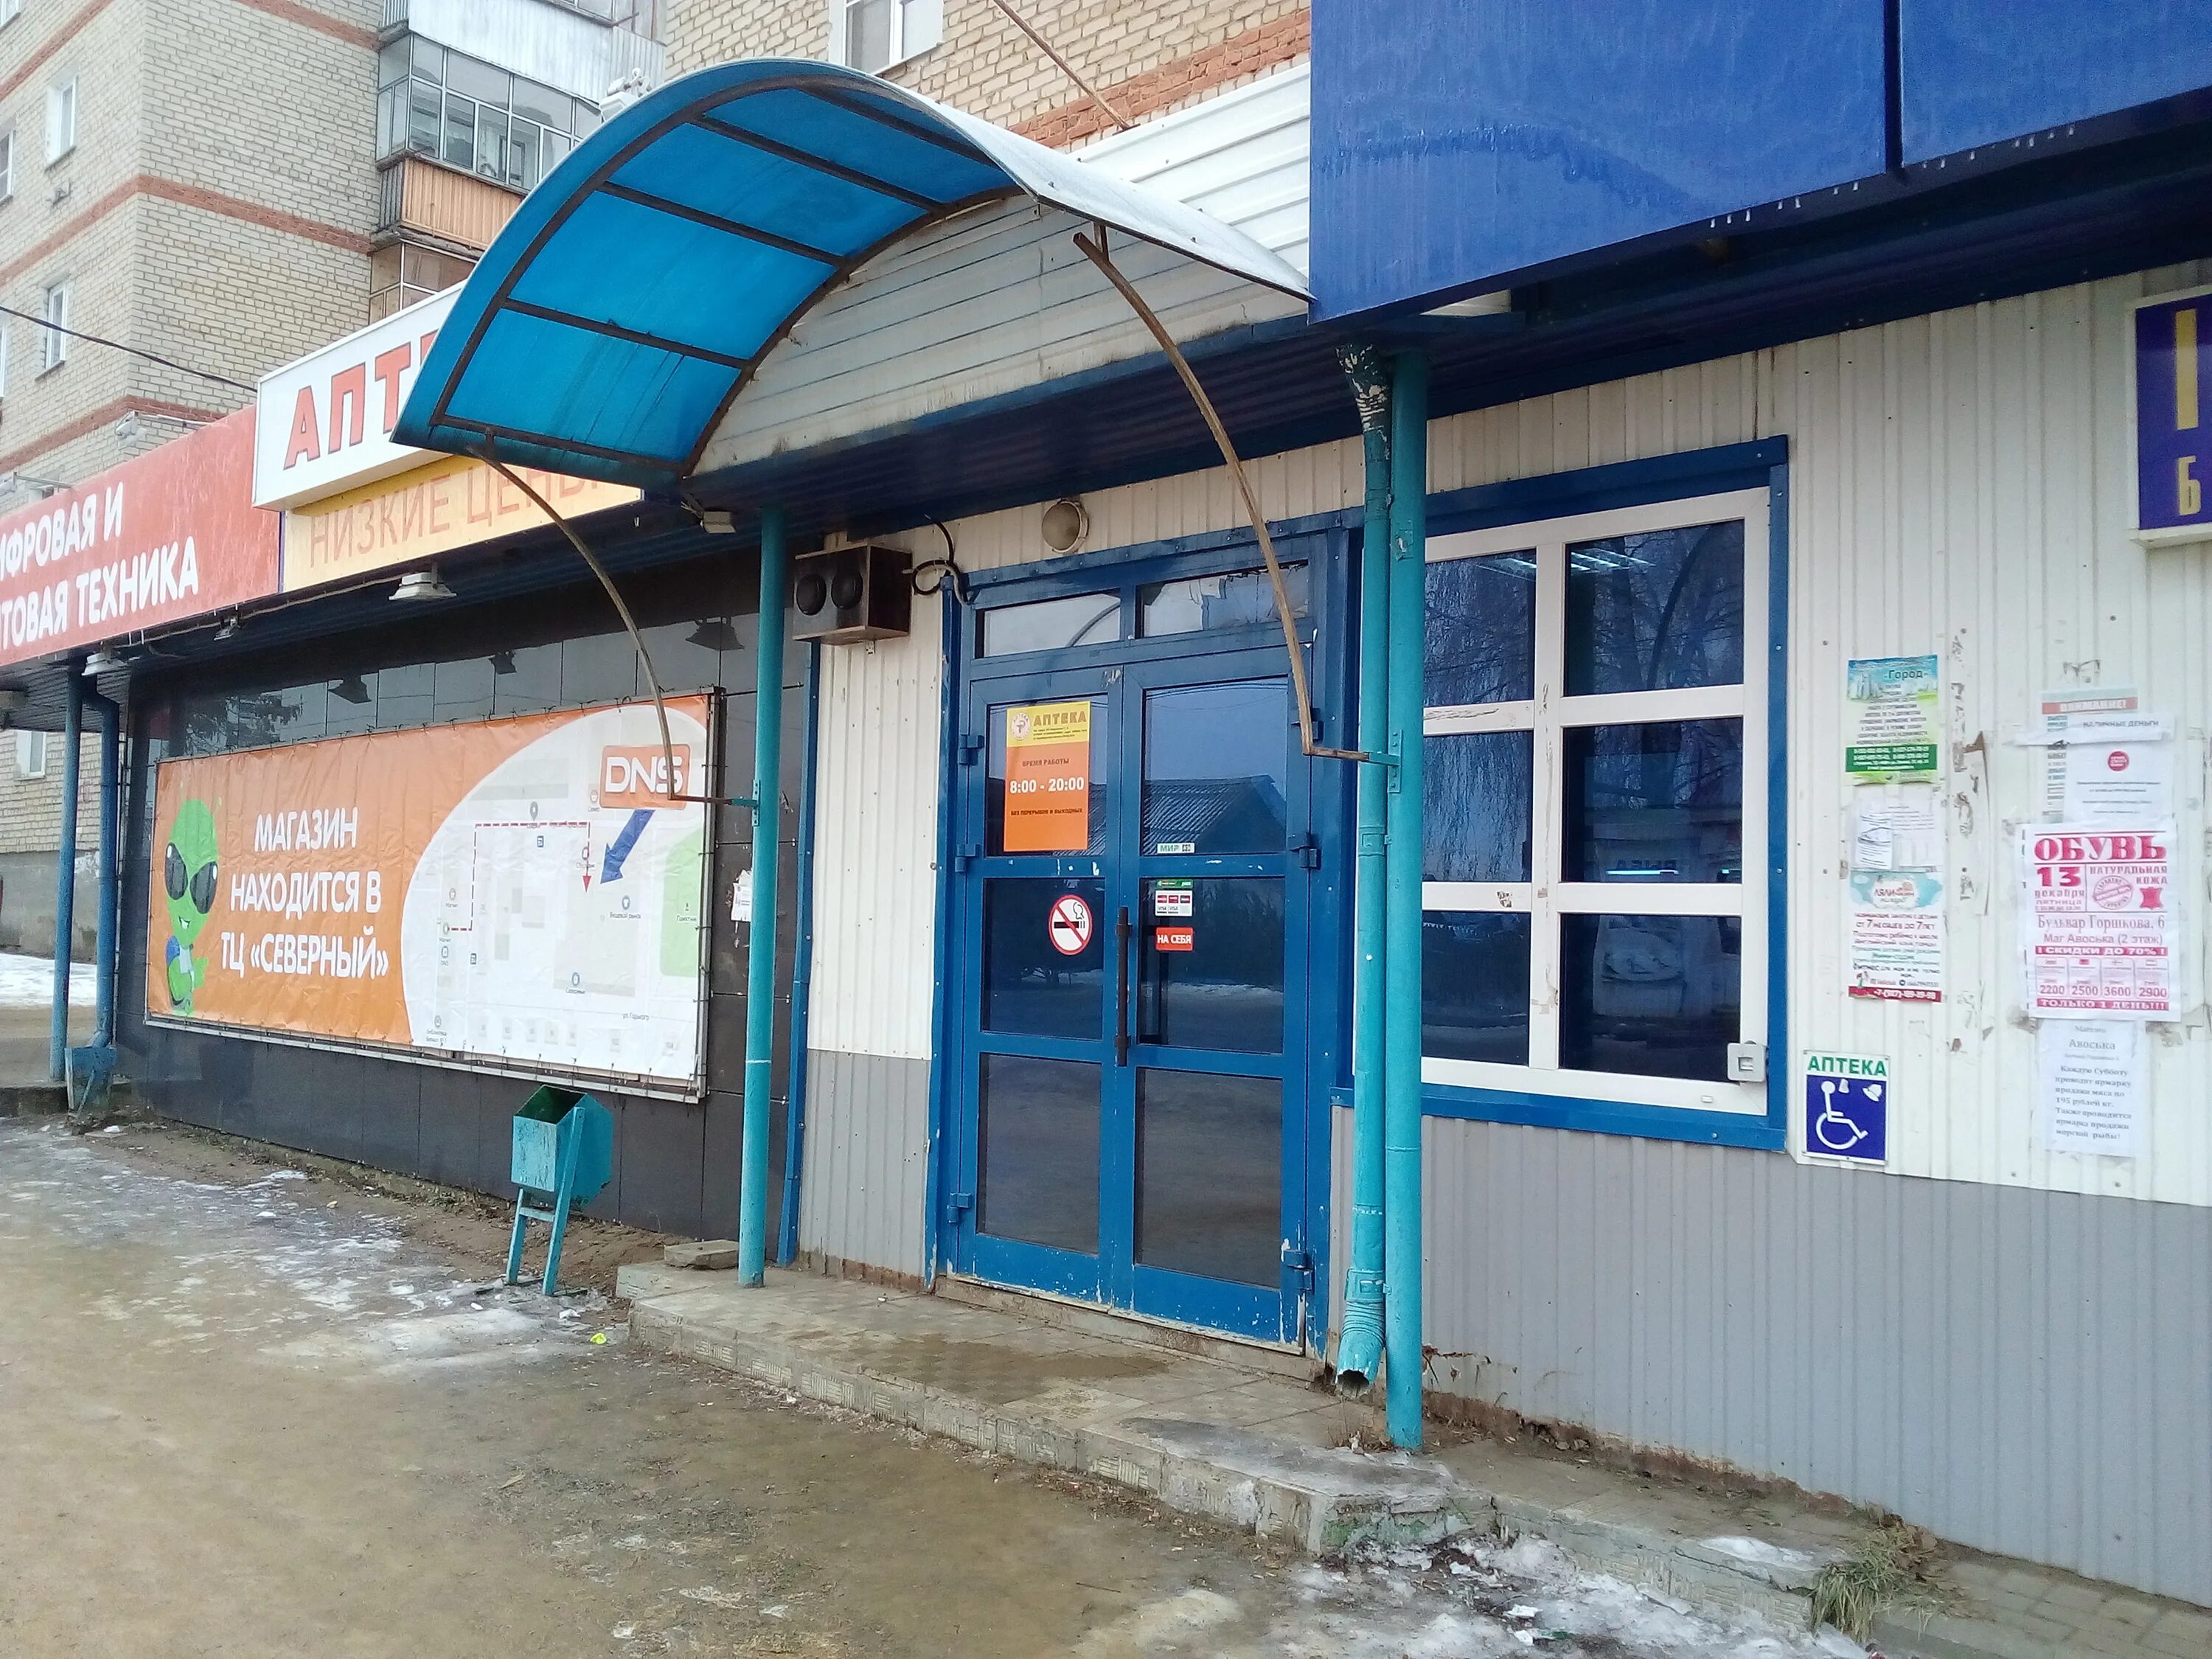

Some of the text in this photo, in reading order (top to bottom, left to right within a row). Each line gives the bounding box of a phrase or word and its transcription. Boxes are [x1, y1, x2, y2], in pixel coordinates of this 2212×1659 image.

[283, 329, 439, 470] АПТ
[103, 481, 123, 542] И
[310, 473, 451, 568] НИЗКИЕ
[0, 536, 198, 650] ТОВАЯ ТЕХНИКА
[1033, 710, 1087, 726] АПТЕКА
[605, 756, 684, 794] DNS
[1009, 779, 1037, 794] 8:00
[1048, 776, 1085, 792] 20:00
[254, 807, 358, 852] МАГАЗИН
[2034, 835, 2167, 861] ОБУВЬ
[2037, 866, 2081, 888] 13
[2090, 865, 2168, 875] НАТУРАЛЬНАЯ
[2136, 876, 2168, 886] КОЖА
[231, 871, 382, 921] НАХОДИТСЯ В
[1867, 919, 1873, 928] 7
[1916, 920, 1922, 930] 7
[2038, 914, 2085, 933] Бульвар
[2157, 914, 2166, 929] 6
[1157, 934, 1192, 944] НА СЕБЯ
[2044, 933, 2163, 946] Маг Авоська (2 этаж)
[221, 925, 389, 980] ТЦ «СЕВЕРНЫЙ»
[2045, 947, 2100, 955] СКИДКИ
[2104, 947, 2124, 956] ДО
[2039, 984, 2168, 998] 2200 2500 3600 2900
[2041, 998, 2096, 1009] ТОЛЬКО
[2111, 1001, 2166, 1010] ДЕНЬ!!!
[2069, 1038, 2116, 1051] Авоська
[1807, 1055, 1887, 1077] АПТЕКА
[2060, 1065, 2128, 1077] Каждую Субботу
[2095, 1079, 2131, 1088] ярмарку
[2073, 1099, 2100, 1107] рублей
[2082, 1110, 2132, 1119] проводится
[2090, 1121, 2129, 1130] продажи
